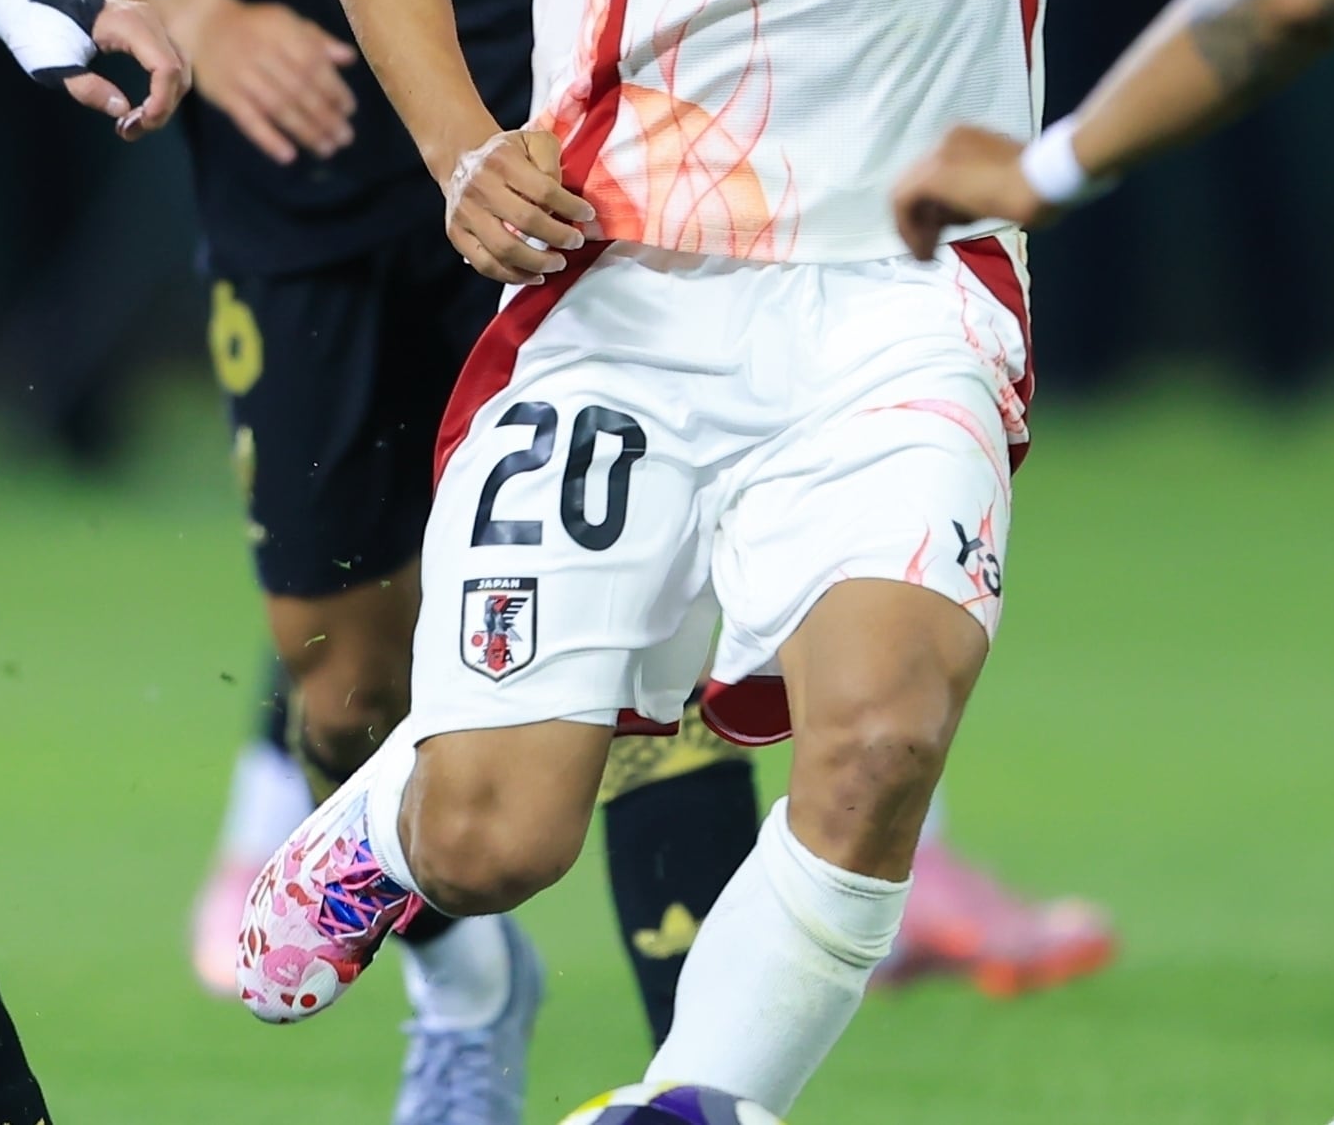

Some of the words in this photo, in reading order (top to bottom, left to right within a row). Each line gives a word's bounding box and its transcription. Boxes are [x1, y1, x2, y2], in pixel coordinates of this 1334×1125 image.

[208, 279, 264, 396] 6
[470, 401, 647, 551] 20
[477, 578, 521, 590] JAPAN
[951, 519, 1001, 597] Y-3
